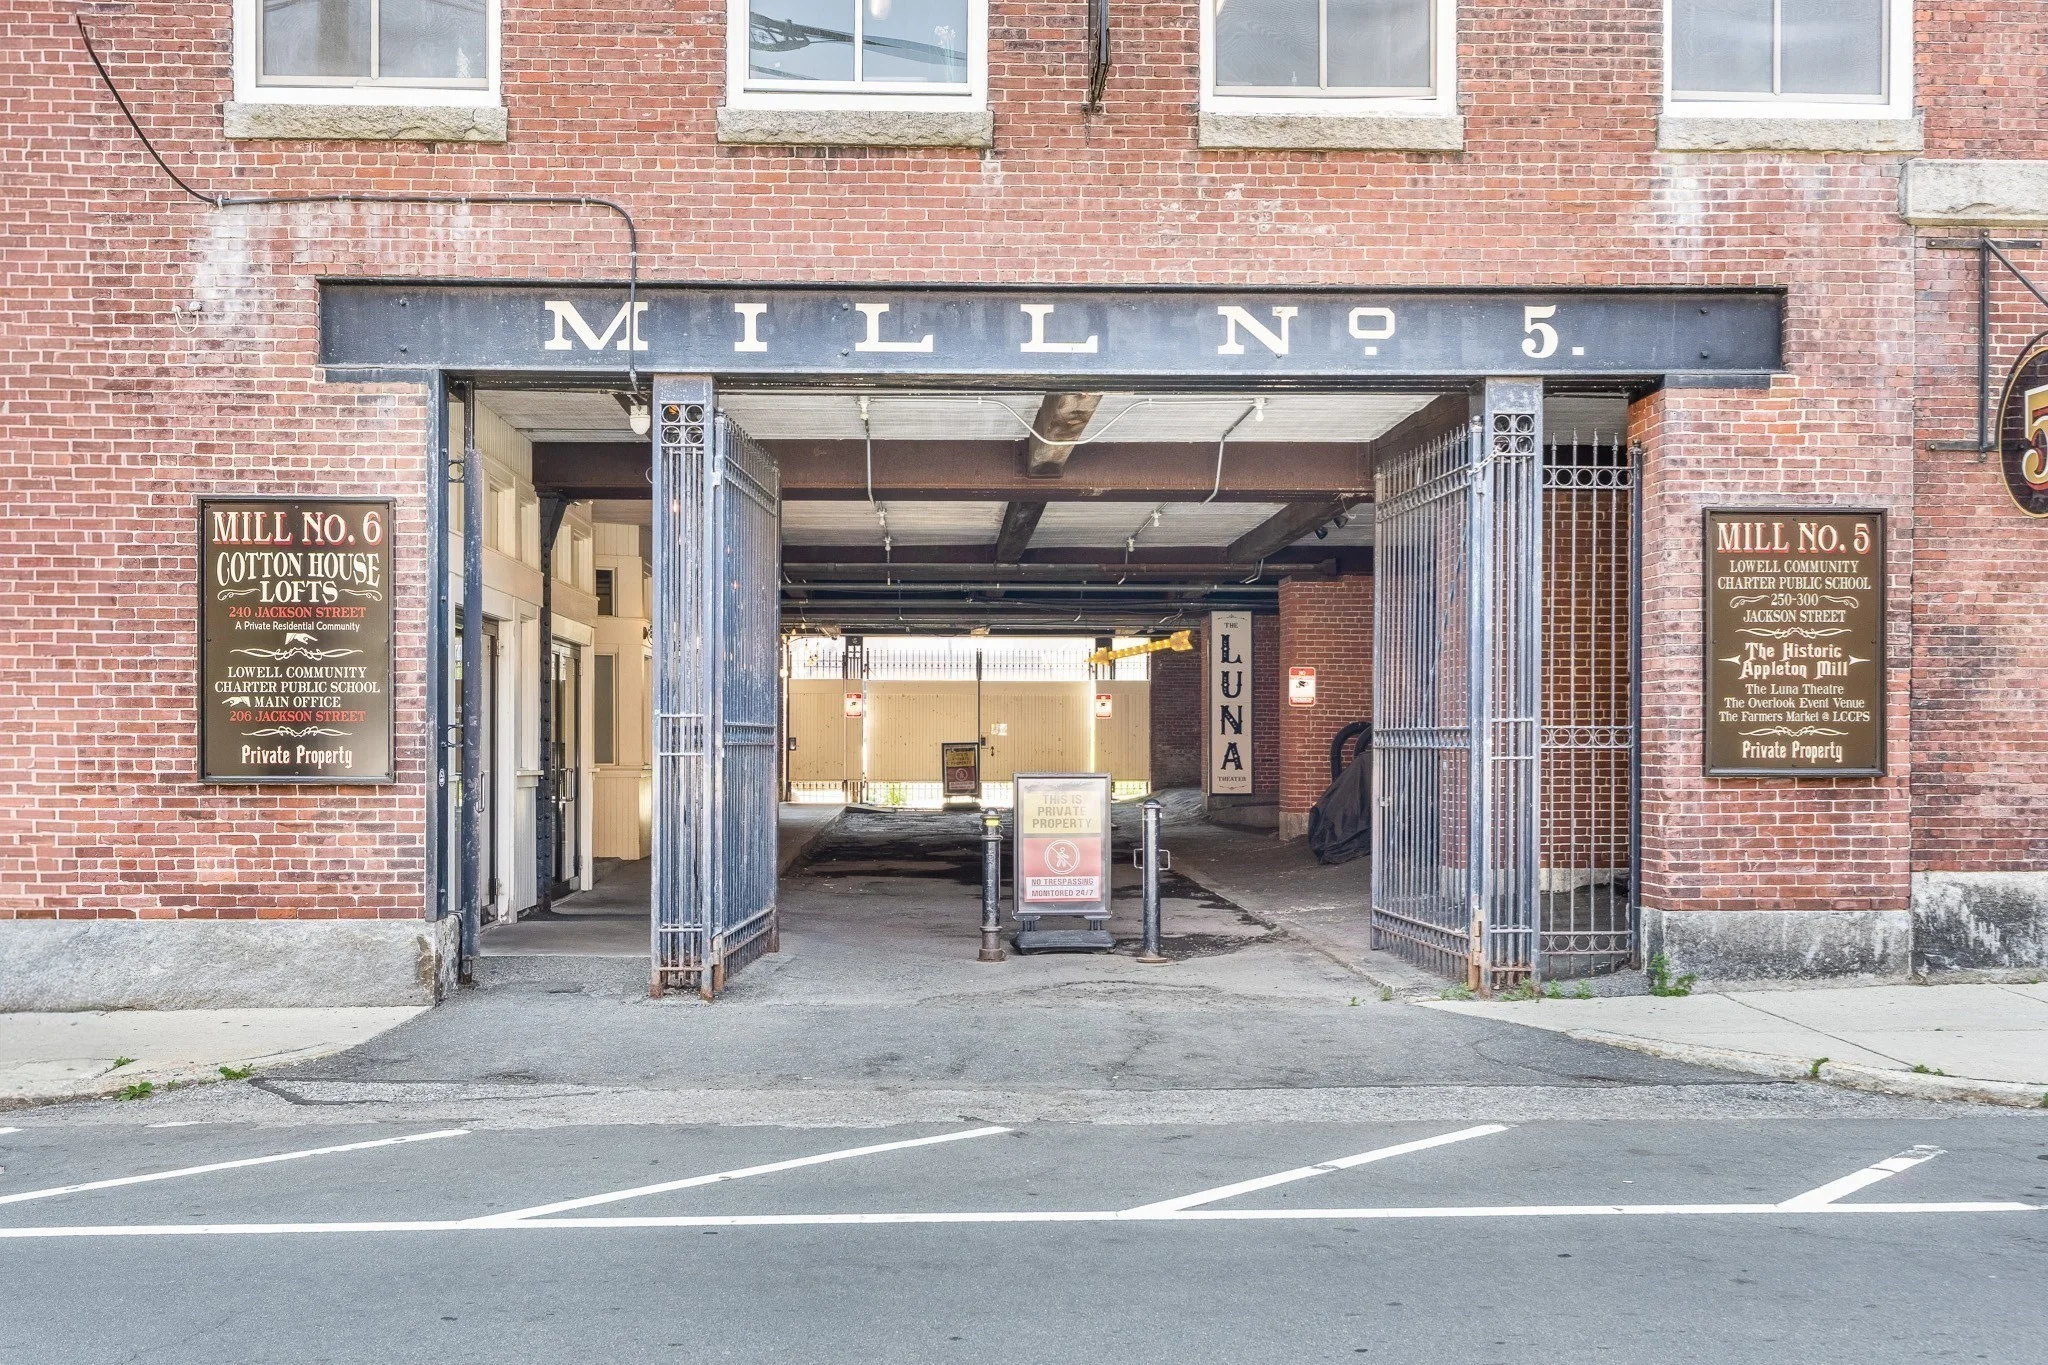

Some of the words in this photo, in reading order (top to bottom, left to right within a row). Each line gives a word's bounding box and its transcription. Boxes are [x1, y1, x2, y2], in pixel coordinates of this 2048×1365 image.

[543, 300, 1098, 354] MILL
[213, 512, 293, 545] MILL
[362, 510, 383, 546] 6
[1717, 523, 1789, 553] MILL
[1853, 523, 1871, 554] 5
[217, 552, 301, 587] COTTON
[308, 552, 380, 588] HOUSE
[1730, 560, 1780, 573] LOWELL
[1784, 560, 1859, 573] COMMUNITY
[1718, 577, 1775, 590] CHARTER
[1779, 577, 1822, 590] PUBLIC
[1825, 577, 1871, 590] SCHOOL
[260, 581, 338, 604] LOFTS
[1771, 594, 1818, 606] 250-300
[229, 607, 251, 618] 240
[255, 607, 312, 618] JACKSON
[316, 607, 366, 618] STREET
[1743, 610, 1796, 622] JACKSON
[1800, 610, 1845, 622] STREET
[235, 622, 242, 630] A
[244, 622, 270, 630] Private
[273, 622, 314, 631] Residential
[316, 622, 360, 632] Community
[1745, 642, 1775, 661] The
[1783, 642, 1842, 661] Historic
[228, 667, 282, 678] LOWELL
[286, 667, 367, 678] COMMUNITY
[1738, 661, 1807, 680] Appleton
[1815, 661, 1847, 680] Mill
[215, 682, 277, 693] CHARTER
[280, 682, 327, 693] PUBLIC
[330, 682, 380, 693] SCHOOL
[1745, 684, 1766, 695] The
[1770, 684, 1798, 695] Luna
[1802, 684, 1844, 695] Theatre
[254, 697, 289, 708] MAIN
[293, 696, 341, 708] OFFICE
[1221, 634, 1243, 770] LUNA
[1724, 698, 1745, 708] The
[1748, 698, 1795, 708] Overlook
[1799, 698, 1829, 708] Event
[1832, 698, 1864, 708] Venue
[230, 711, 251, 722] 206
[255, 711, 312, 722] JACKSON
[316, 711, 366, 722] STREET
[1719, 712, 1738, 722] The
[1741, 712, 1783, 722] Farmers
[1786, 711, 1819, 722] Market
[1832, 712, 1870, 722] LCCPS
[242, 745, 290, 764] Private
[296, 745, 352, 769] Property
[1742, 741, 1786, 759] Private
[1792, 741, 1843, 763] Property
[1043, 795, 1067, 804] THIS
[1072, 795, 1082, 804] IS
[1038, 807, 1086, 816] PRIVATE
[1033, 819, 1092, 828] PROPERTY
